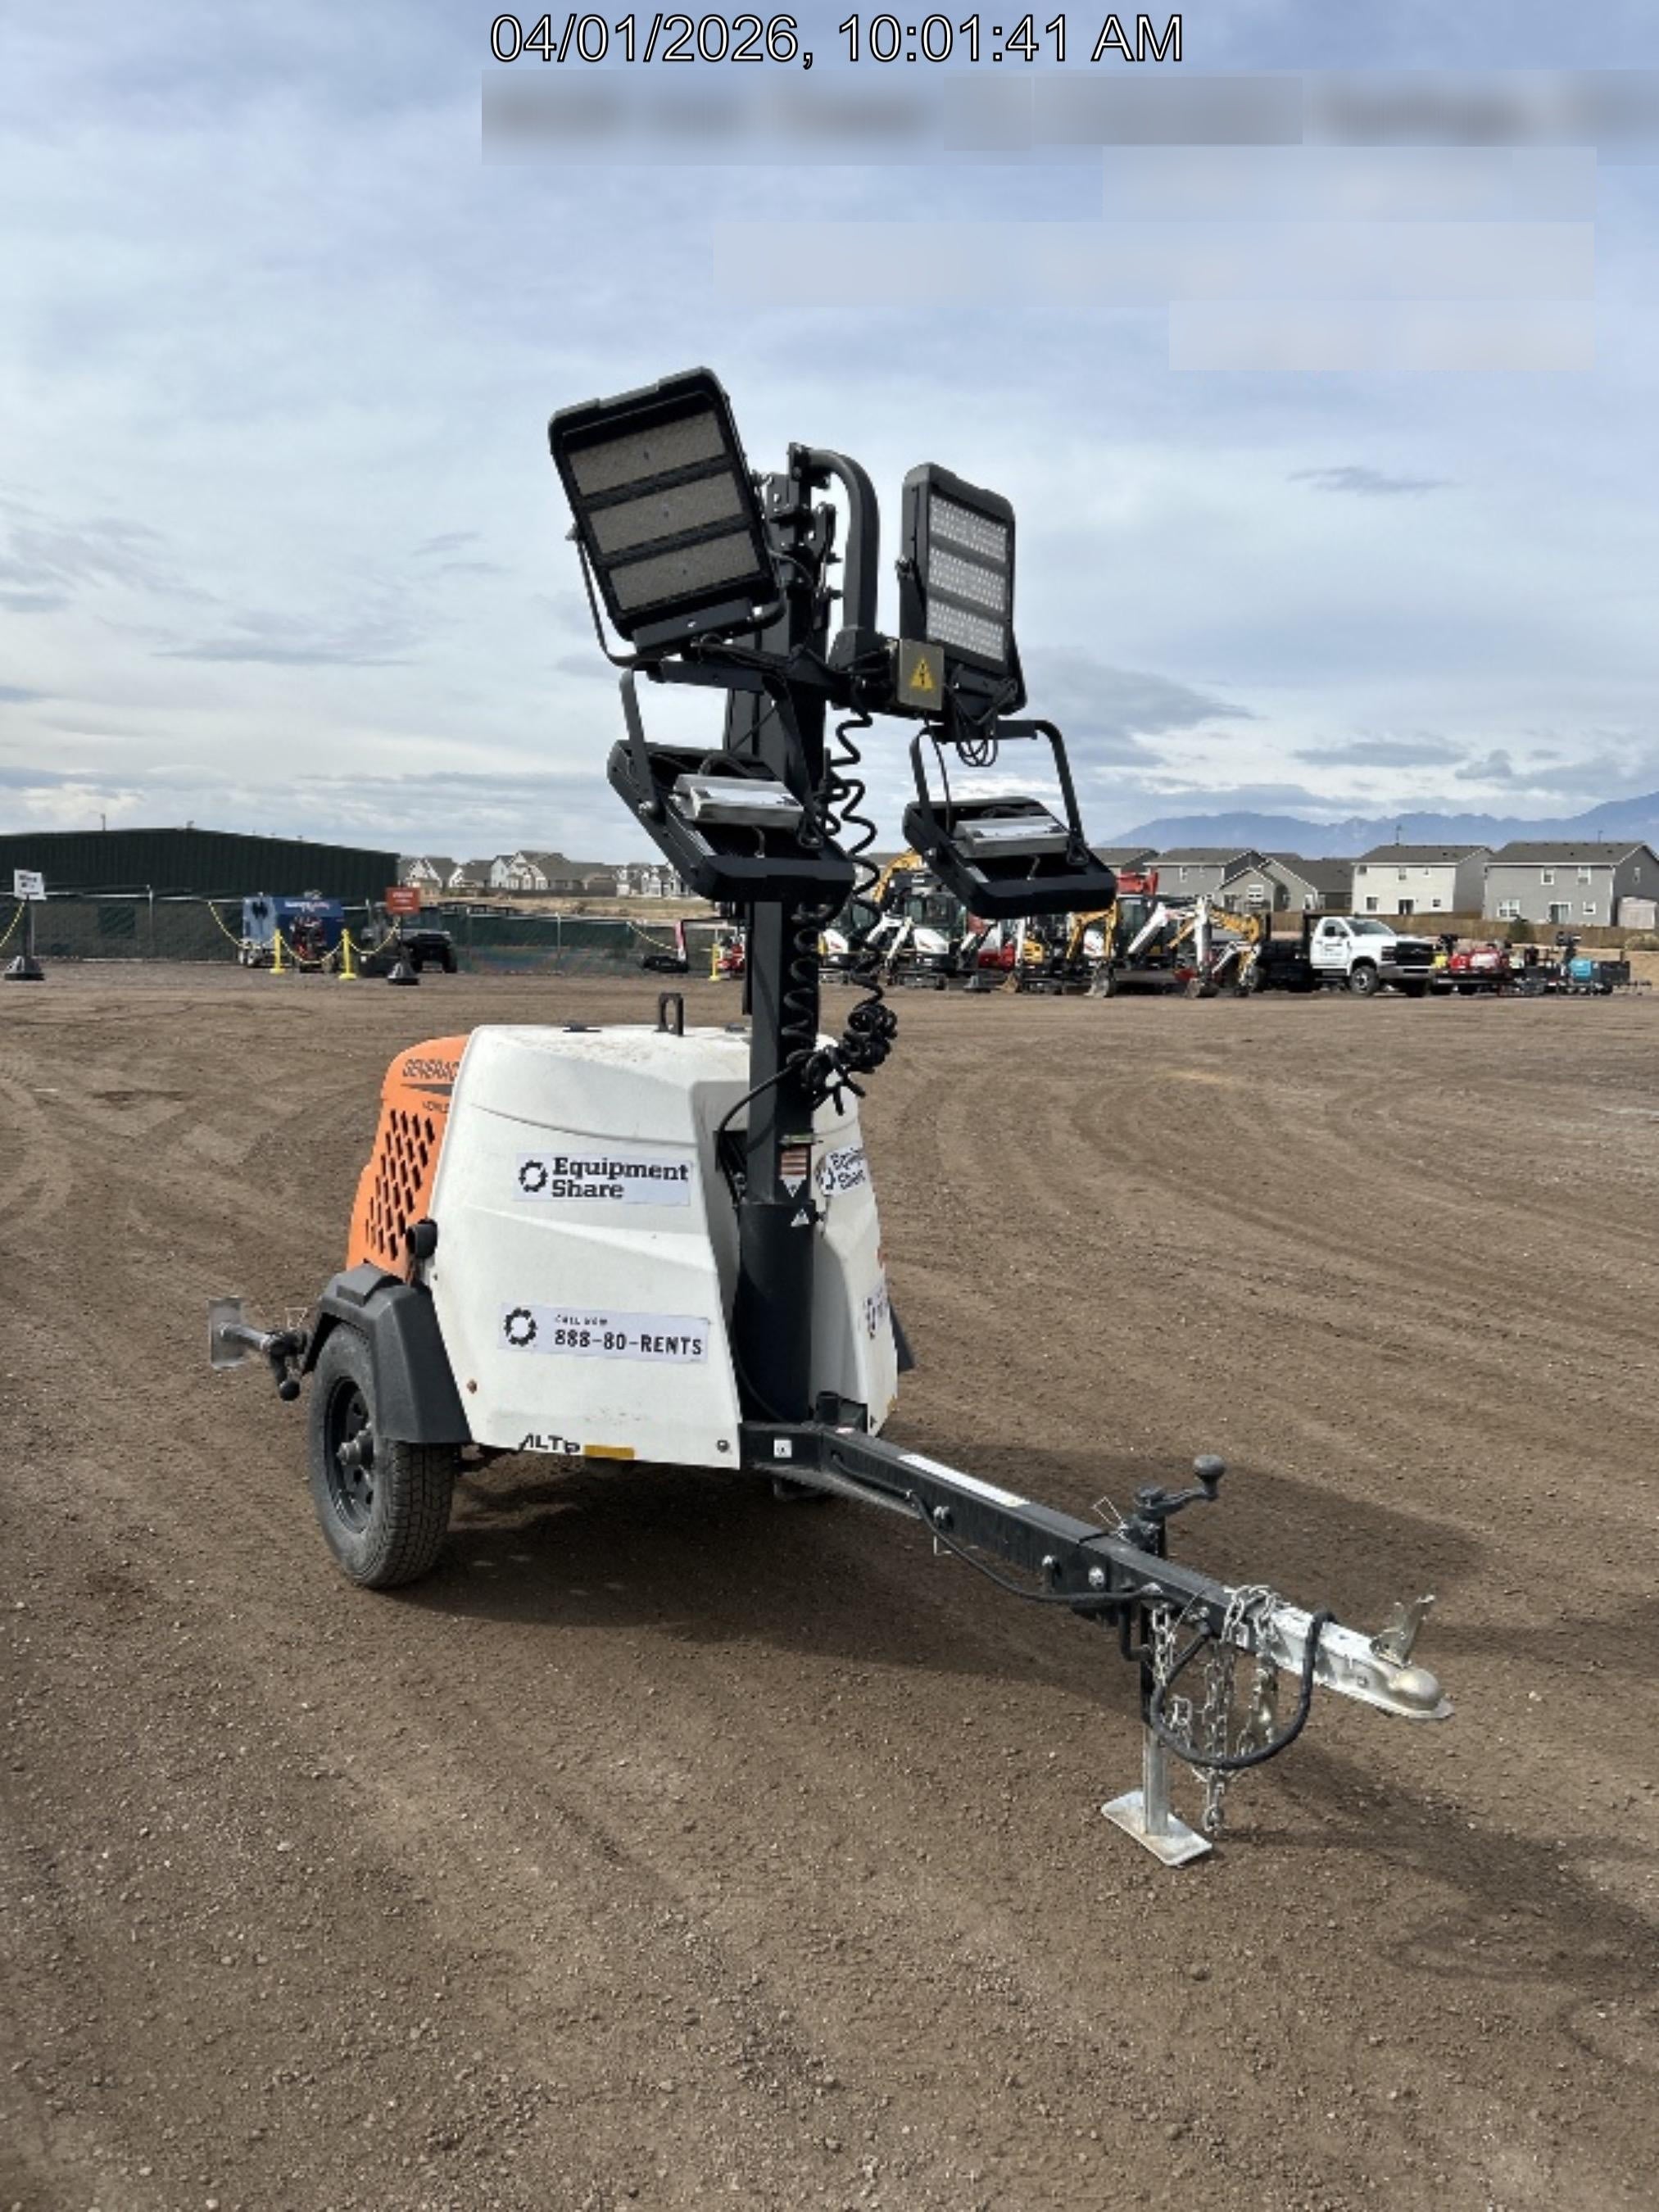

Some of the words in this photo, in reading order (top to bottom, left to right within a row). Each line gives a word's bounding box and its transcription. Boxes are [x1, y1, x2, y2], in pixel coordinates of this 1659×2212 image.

[552, 1157, 689, 1181] Equipment
[551, 1179, 624, 1199] Share
[554, 1328, 703, 1356] 888-80-RENTS
